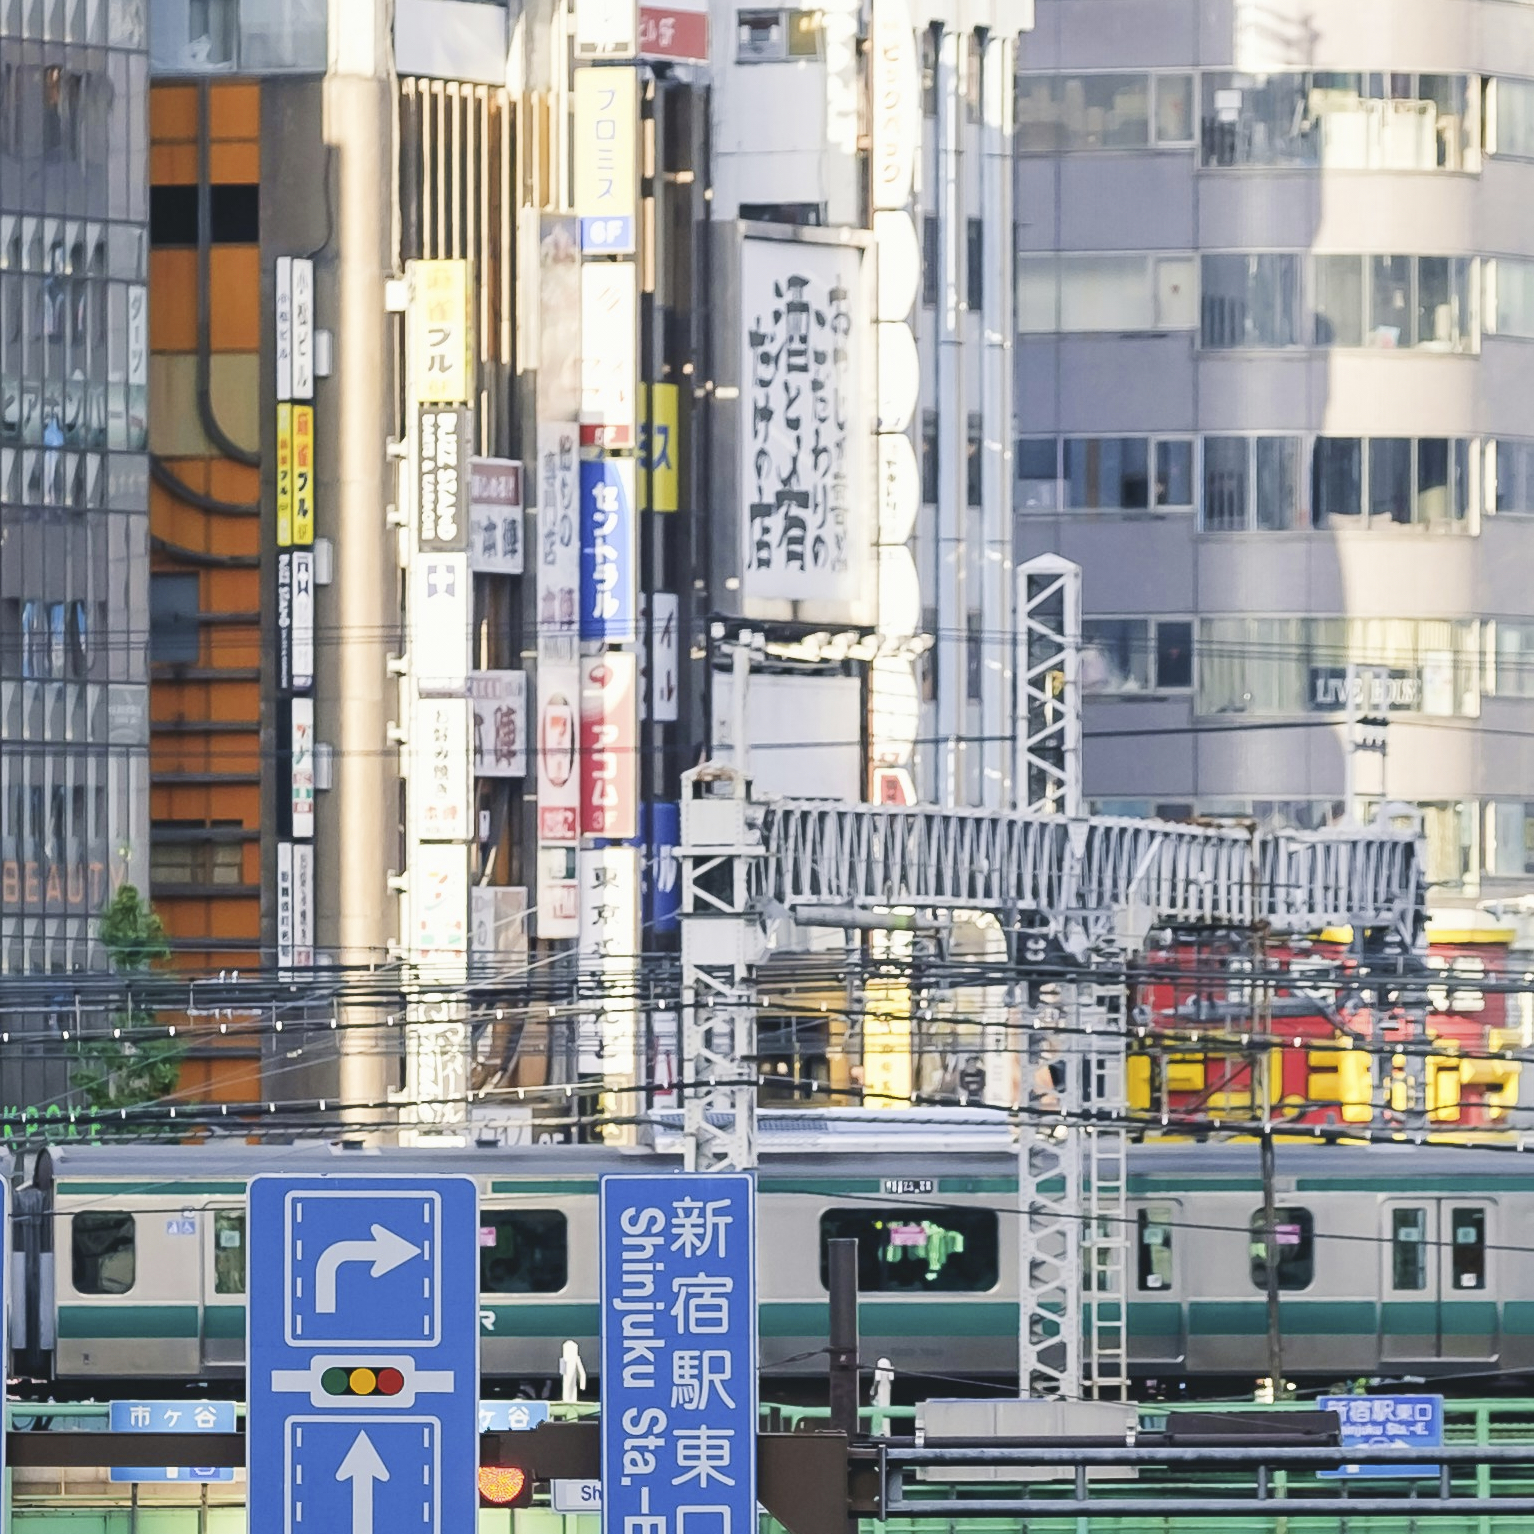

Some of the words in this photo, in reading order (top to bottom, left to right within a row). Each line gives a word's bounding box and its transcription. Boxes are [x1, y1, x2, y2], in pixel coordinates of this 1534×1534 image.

[596, 89, 616, 199] プロミス
[589, 219, 625, 245] 6F
[591, 480, 620, 620] セントラル
[590, 724, 620, 807] アコム
[2, 860, 125, 903] BEAUTY
[619, 1205, 666, 1391] Shinjuku
